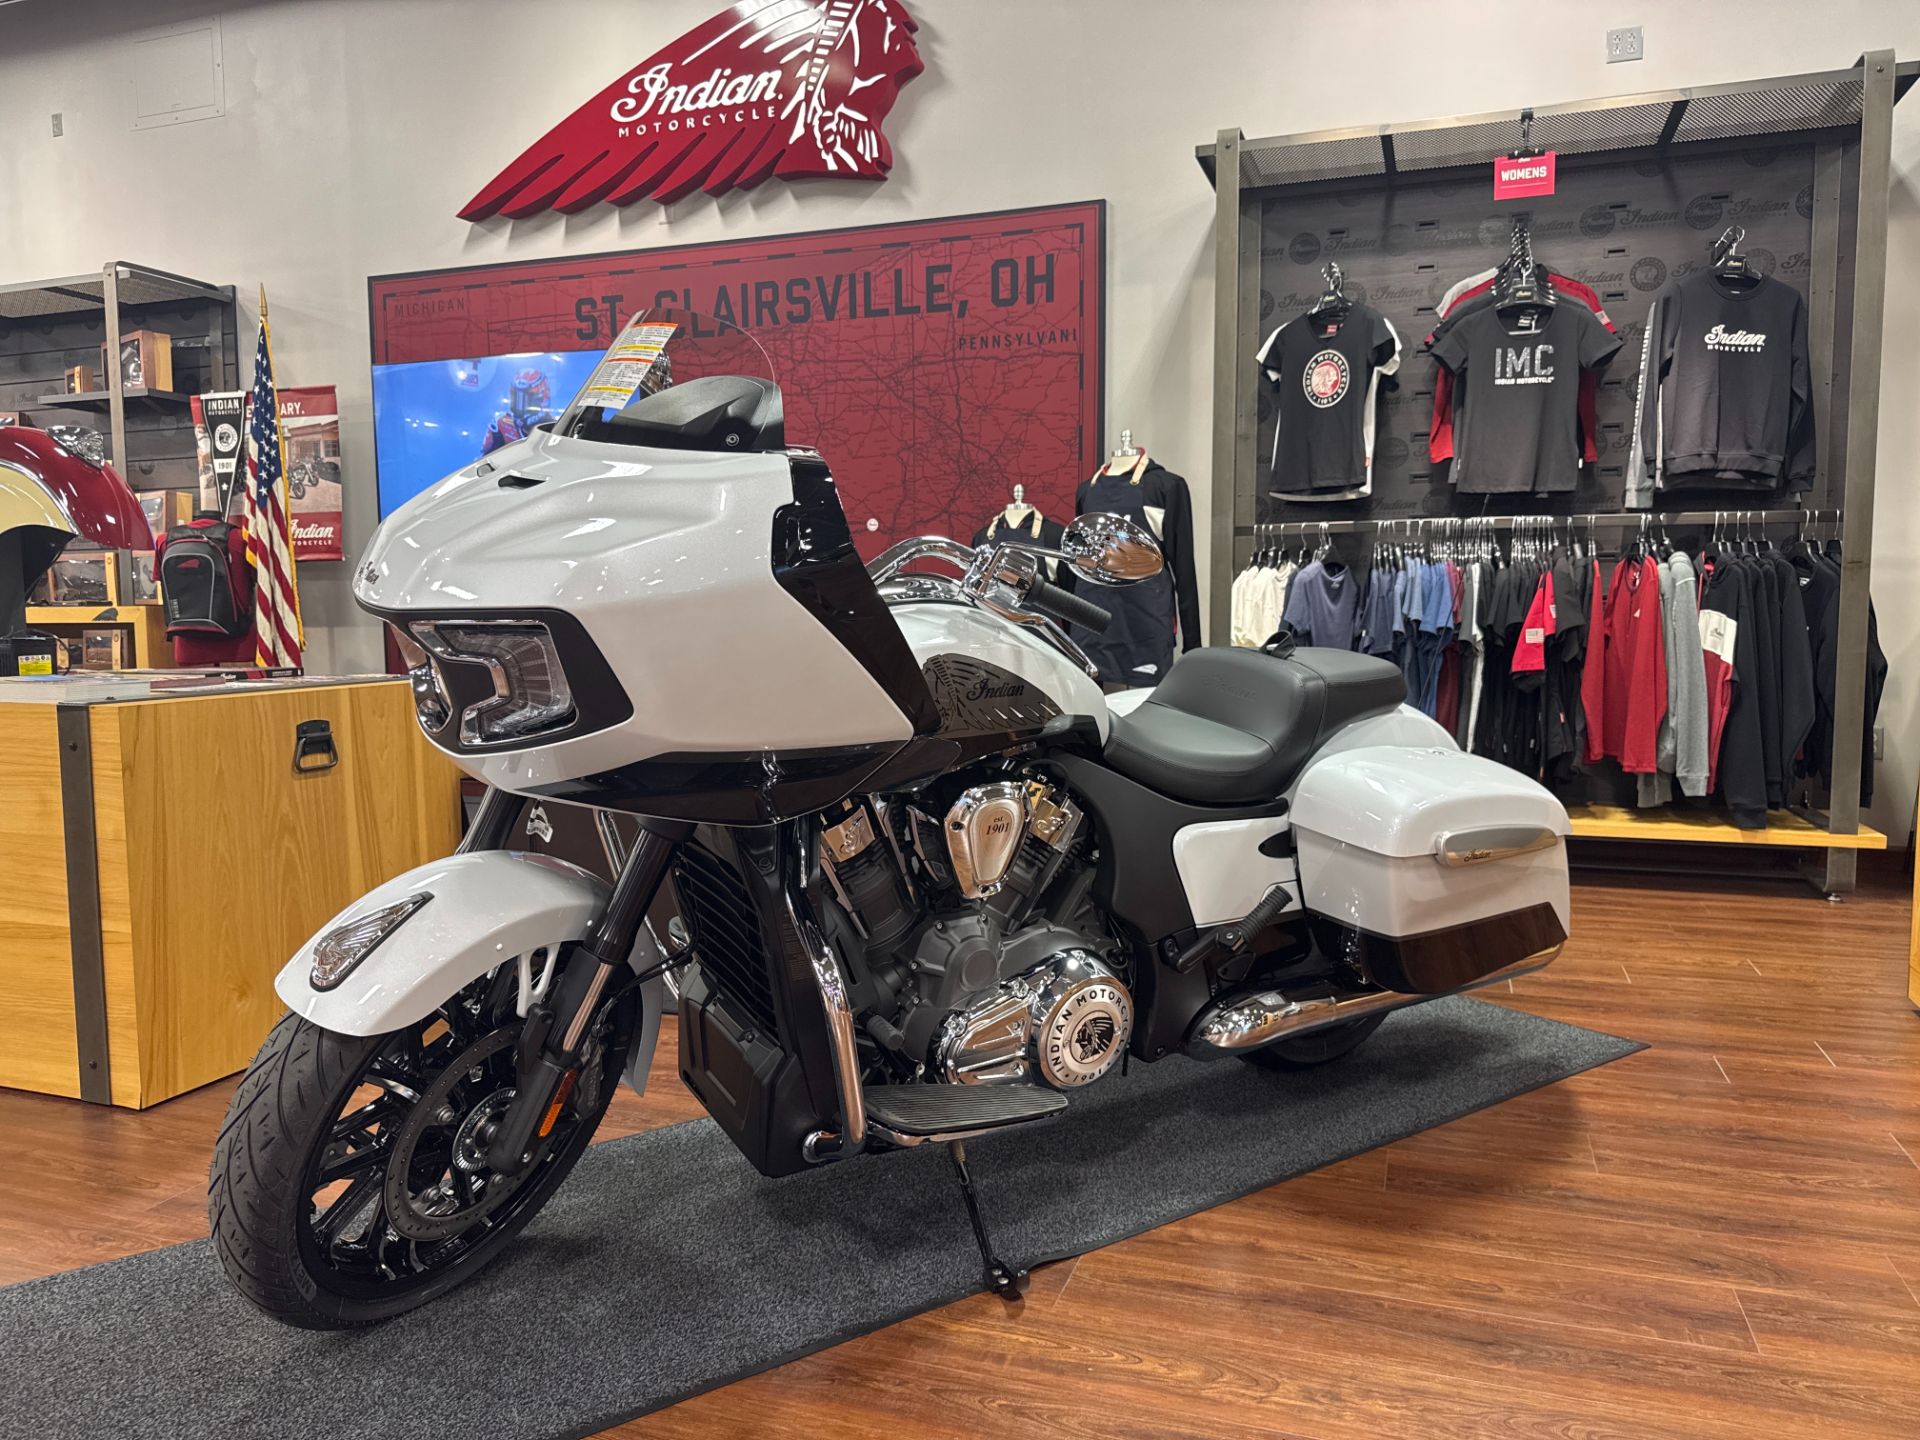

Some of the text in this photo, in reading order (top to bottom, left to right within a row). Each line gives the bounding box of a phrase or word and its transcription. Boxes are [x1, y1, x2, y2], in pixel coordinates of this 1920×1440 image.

[618, 106, 775, 138] MOTORCYCLE
[1501, 166, 1547, 182] WOMENS
[991, 253, 1055, 308] OH
[394, 298, 465, 318] MICHIGAN
[1495, 344, 1554, 378] IMC
[1305, 353, 1347, 397] INDIAN MOTORCYCLE
[208, 399, 240, 411] INDIAN
[218, 461, 233, 470] 1901
[966, 678, 1025, 701] Indian
[986, 822, 1010, 835] 1901
[1050, 988, 1129, 1073] INDIAN MOTORCYCLE
[1072, 1068, 1102, 1083] 1901
